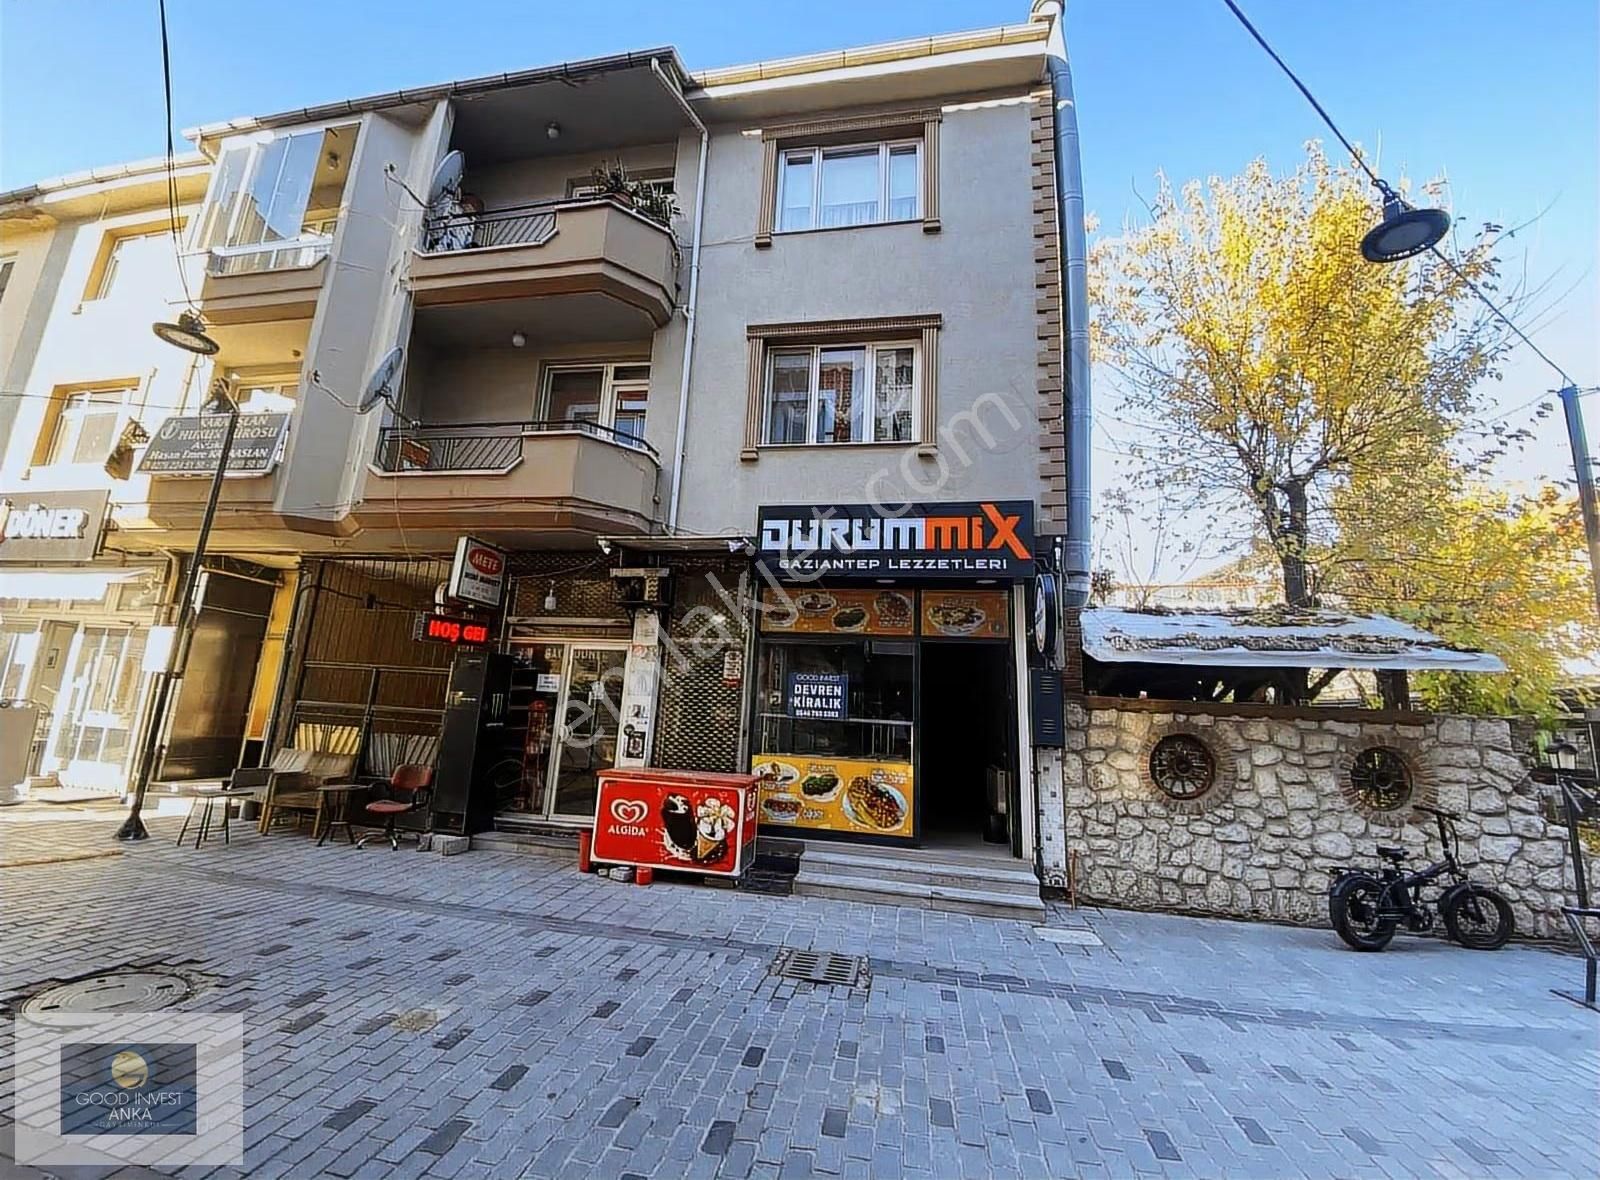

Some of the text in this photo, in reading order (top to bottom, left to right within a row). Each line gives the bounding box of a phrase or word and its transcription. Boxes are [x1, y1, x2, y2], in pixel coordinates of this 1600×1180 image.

[201, 416, 268, 428] KARASLAN
[178, 429, 222, 440] HUKUK
[472, 552, 499, 571] METE
[794, 684, 841, 696] DEVREN
[793, 696, 841, 709] KİRALIK
